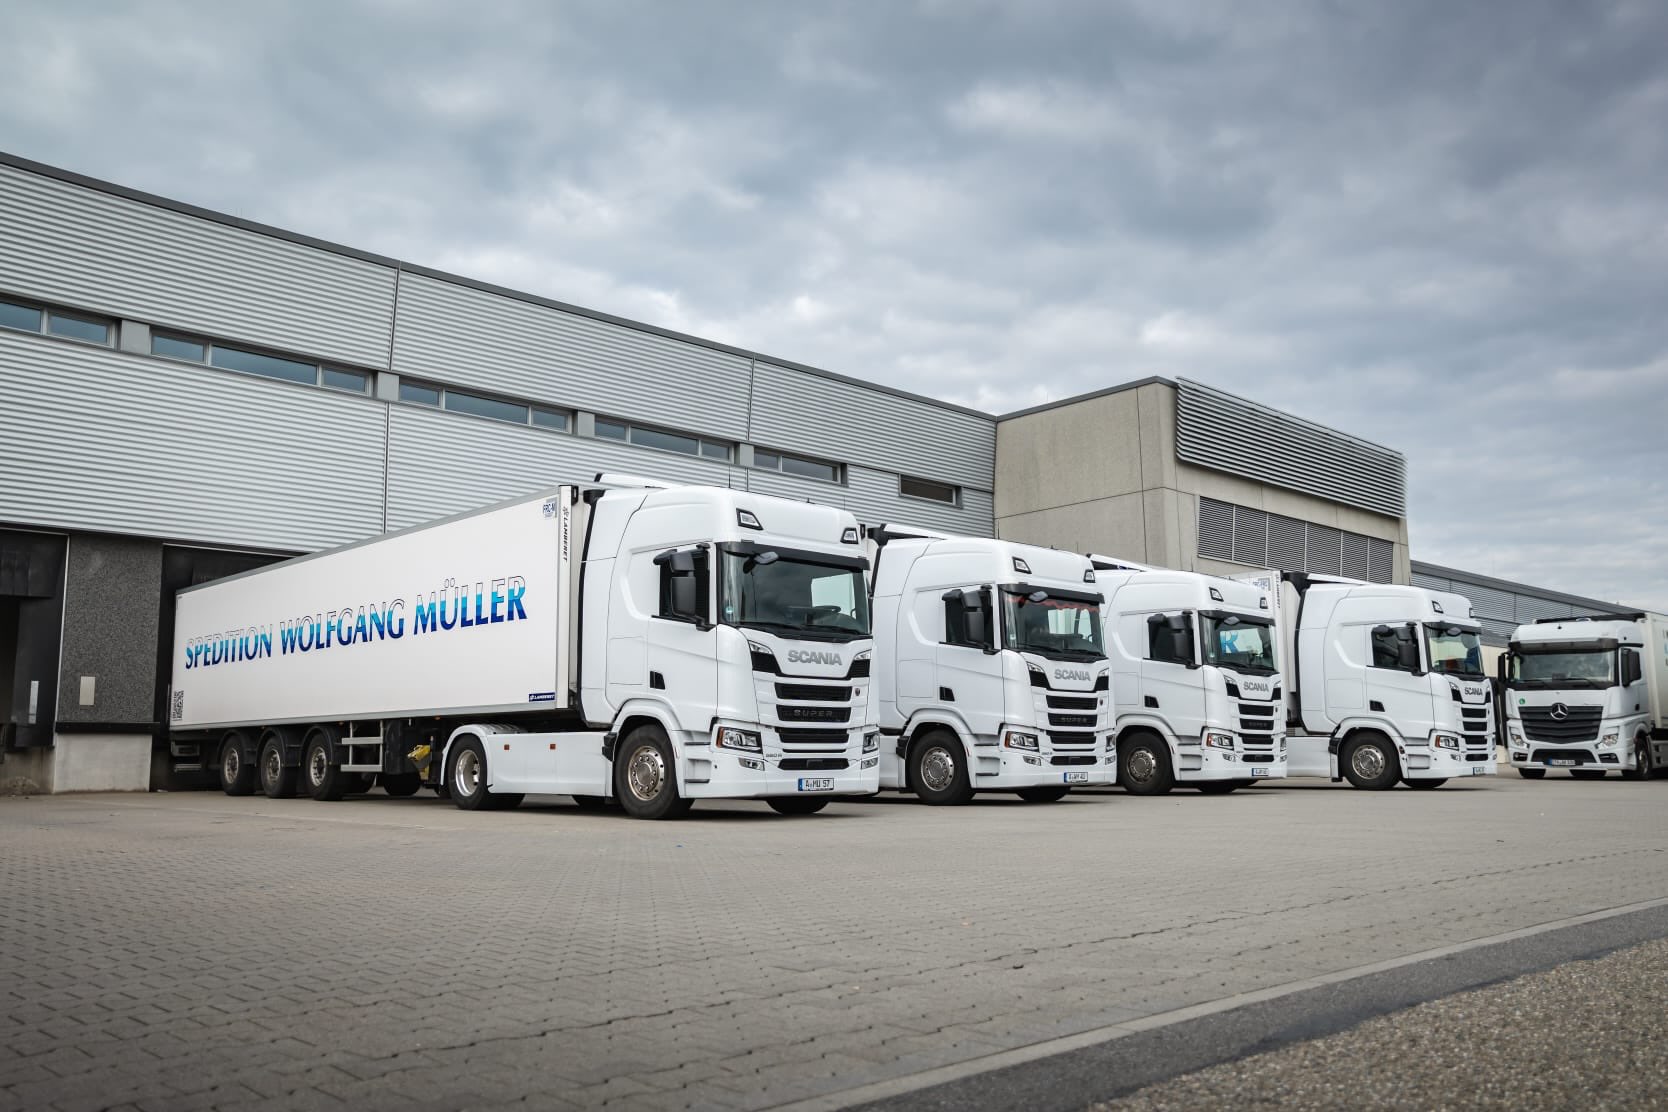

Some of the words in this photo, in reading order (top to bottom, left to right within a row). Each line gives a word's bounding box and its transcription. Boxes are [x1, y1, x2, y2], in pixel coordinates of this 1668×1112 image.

[185, 624, 273, 669] SPEDITION
[279, 598, 405, 655] WOLFGANG
[413, 575, 528, 636] MÜLLER
[787, 649, 843, 665] SCANIA
[1054, 669, 1091, 681] SCANIA
[1243, 681, 1269, 692] SCANIA
[1464, 686, 1483, 696] SCANIA
[793, 709, 833, 718] SUPER
